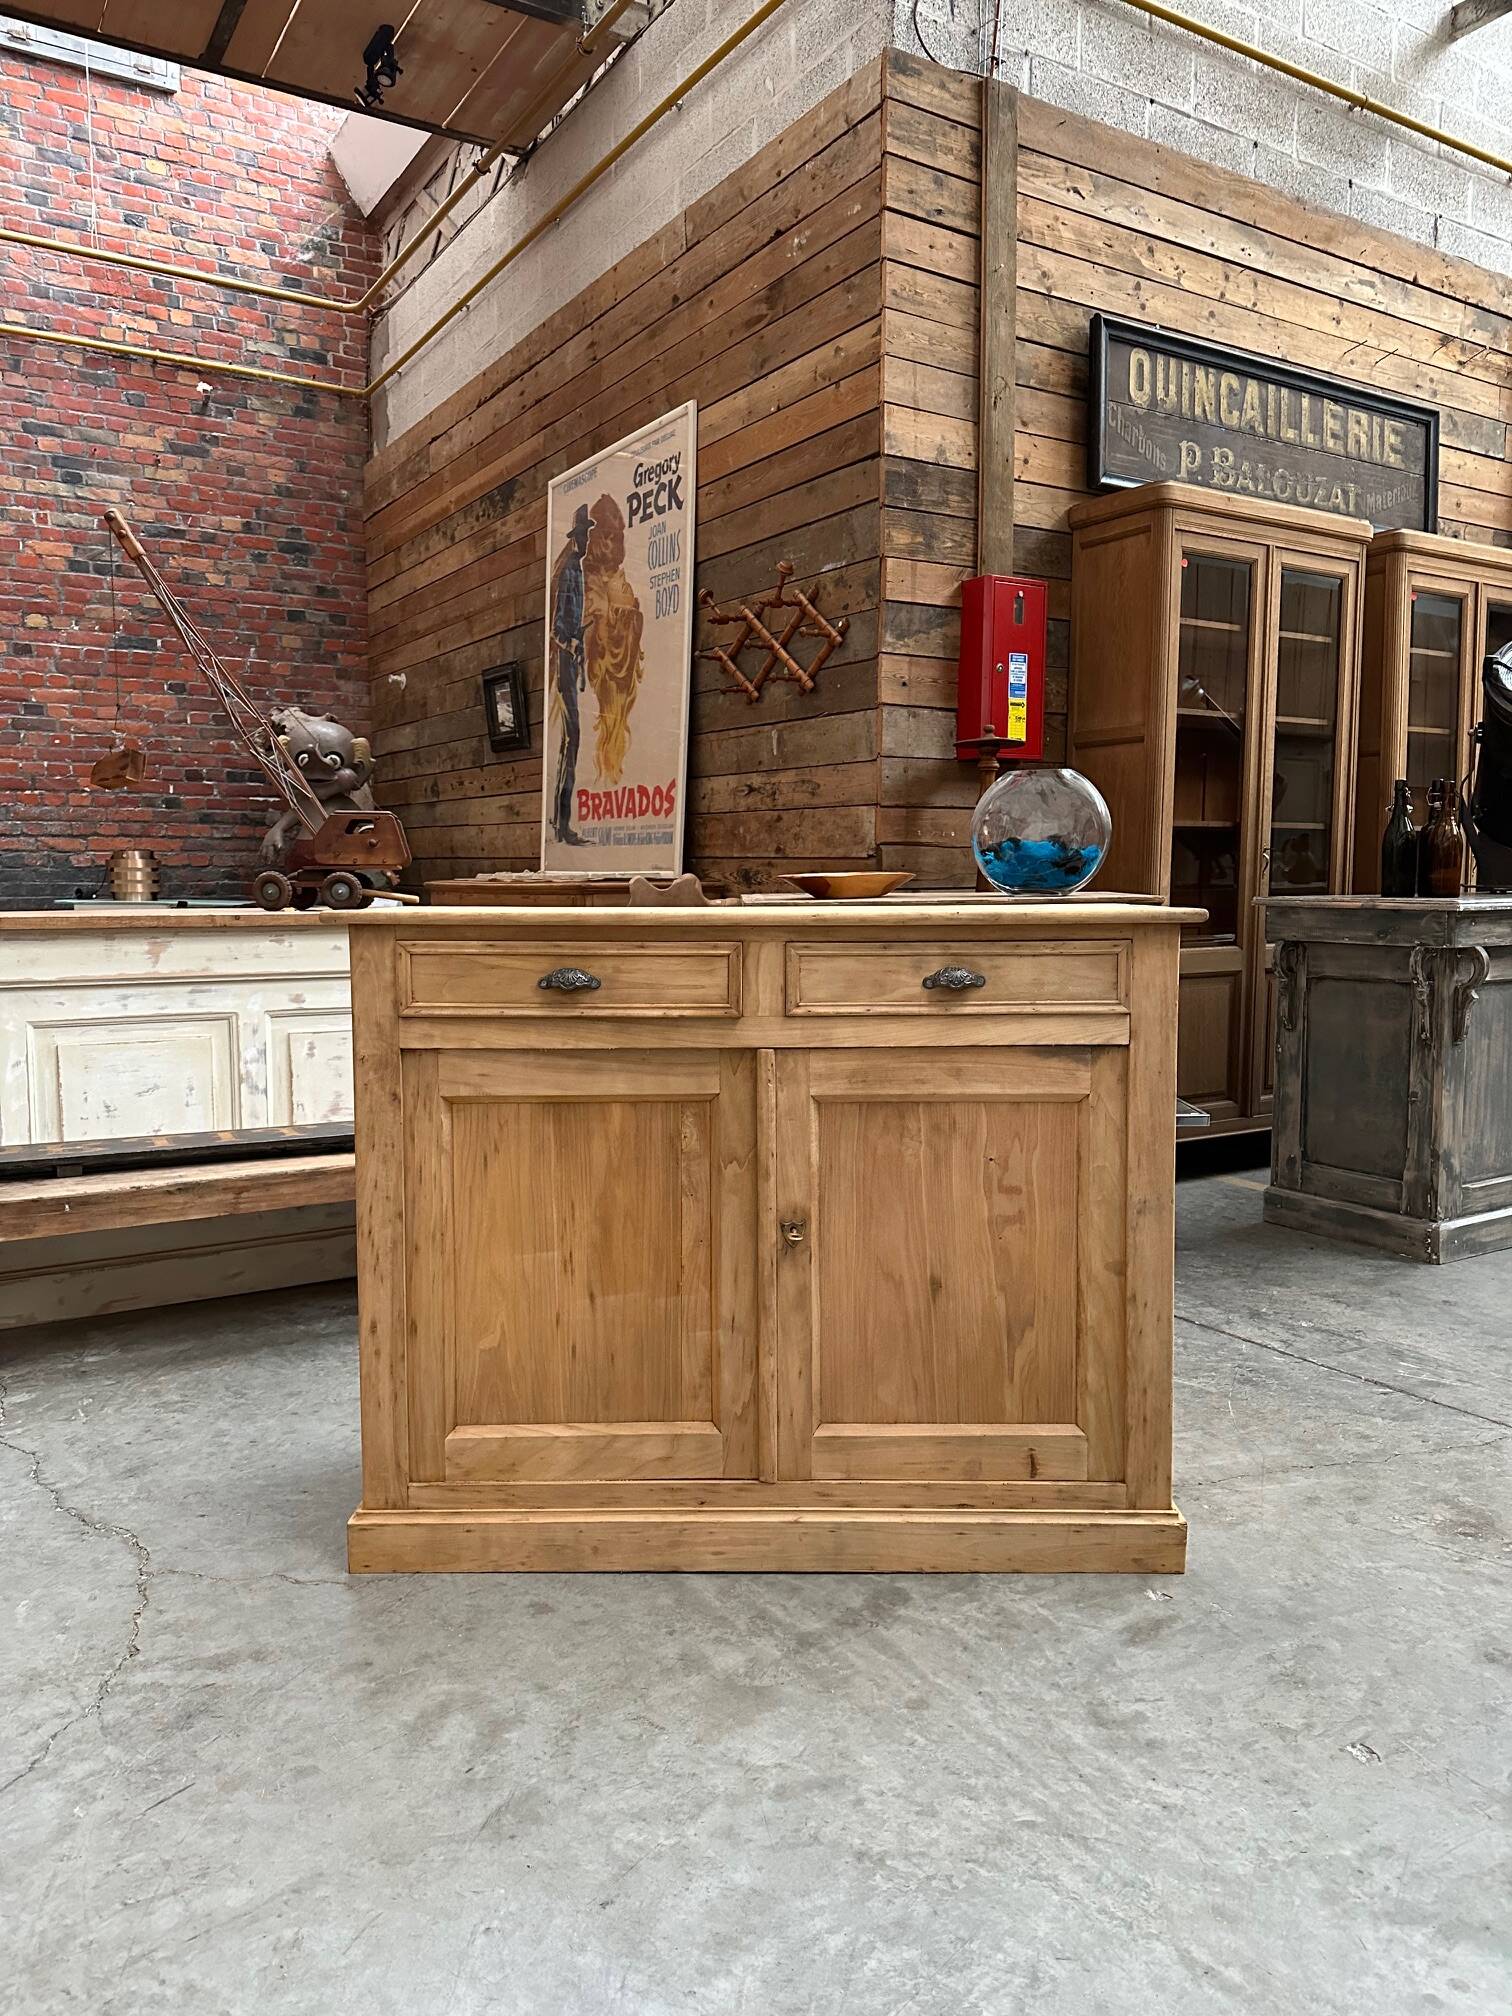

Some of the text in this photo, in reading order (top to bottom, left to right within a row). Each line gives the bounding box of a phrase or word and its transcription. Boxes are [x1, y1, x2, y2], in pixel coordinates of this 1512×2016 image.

[1128, 347, 1407, 465] QUINCAILLERIE
[633, 451, 681, 488] Gregory
[627, 474, 684, 528] PECK
[648, 520, 667, 540] JOAN
[648, 529, 681, 571] COLLINS
[649, 567, 681, 590] STEPHEN
[656, 584, 680, 619] BOYD
[576, 778, 677, 821] BRAVADOS
